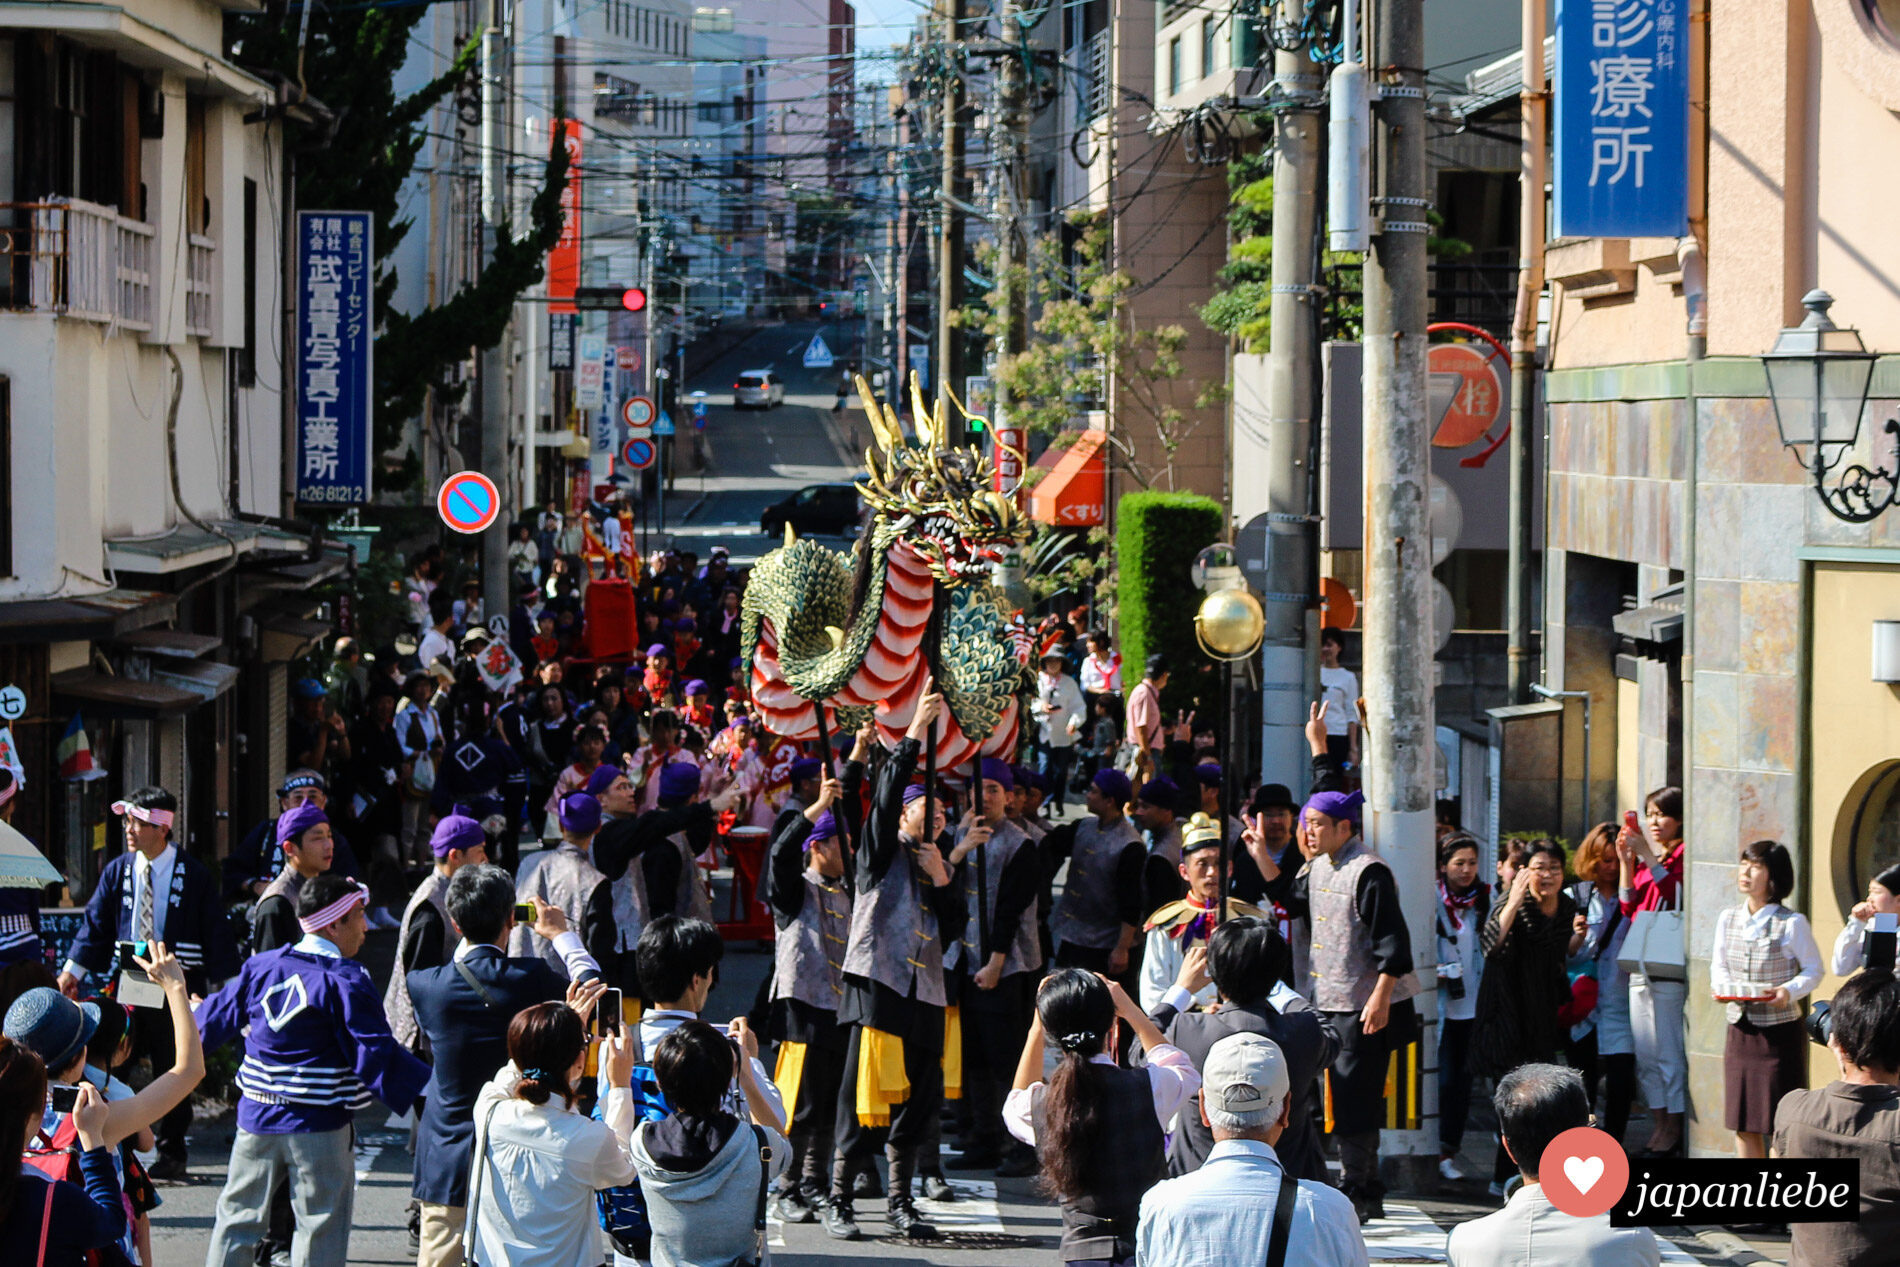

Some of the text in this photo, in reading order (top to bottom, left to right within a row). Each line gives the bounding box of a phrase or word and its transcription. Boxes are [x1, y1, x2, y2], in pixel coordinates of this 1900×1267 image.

[1588, 0, 1655, 188] 診療所
[630, 405, 647, 420] 30
[1061, 504, 1104, 520] くすり
